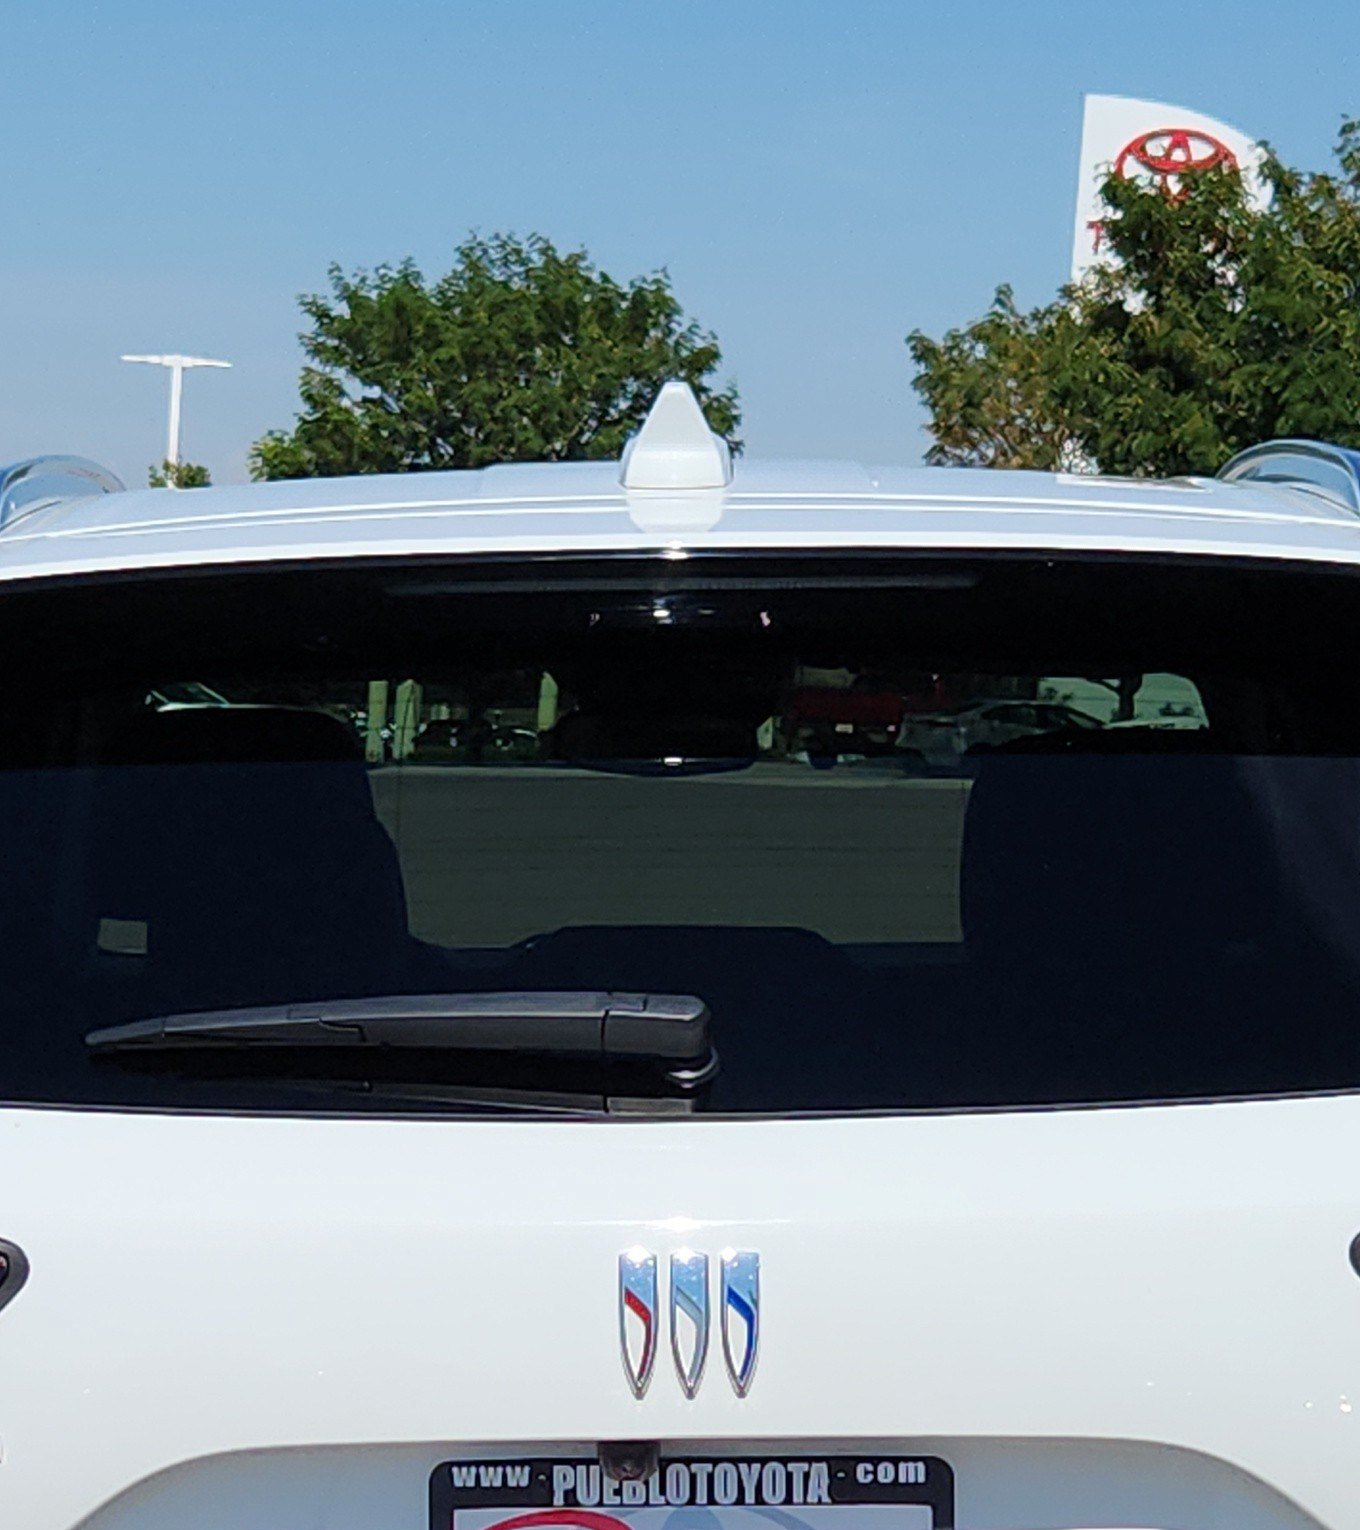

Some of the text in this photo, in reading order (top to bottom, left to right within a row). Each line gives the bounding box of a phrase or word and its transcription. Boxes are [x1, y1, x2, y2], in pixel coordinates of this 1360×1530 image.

[451, 1460, 927, 1507] www PUEBLOTOYOTA com
